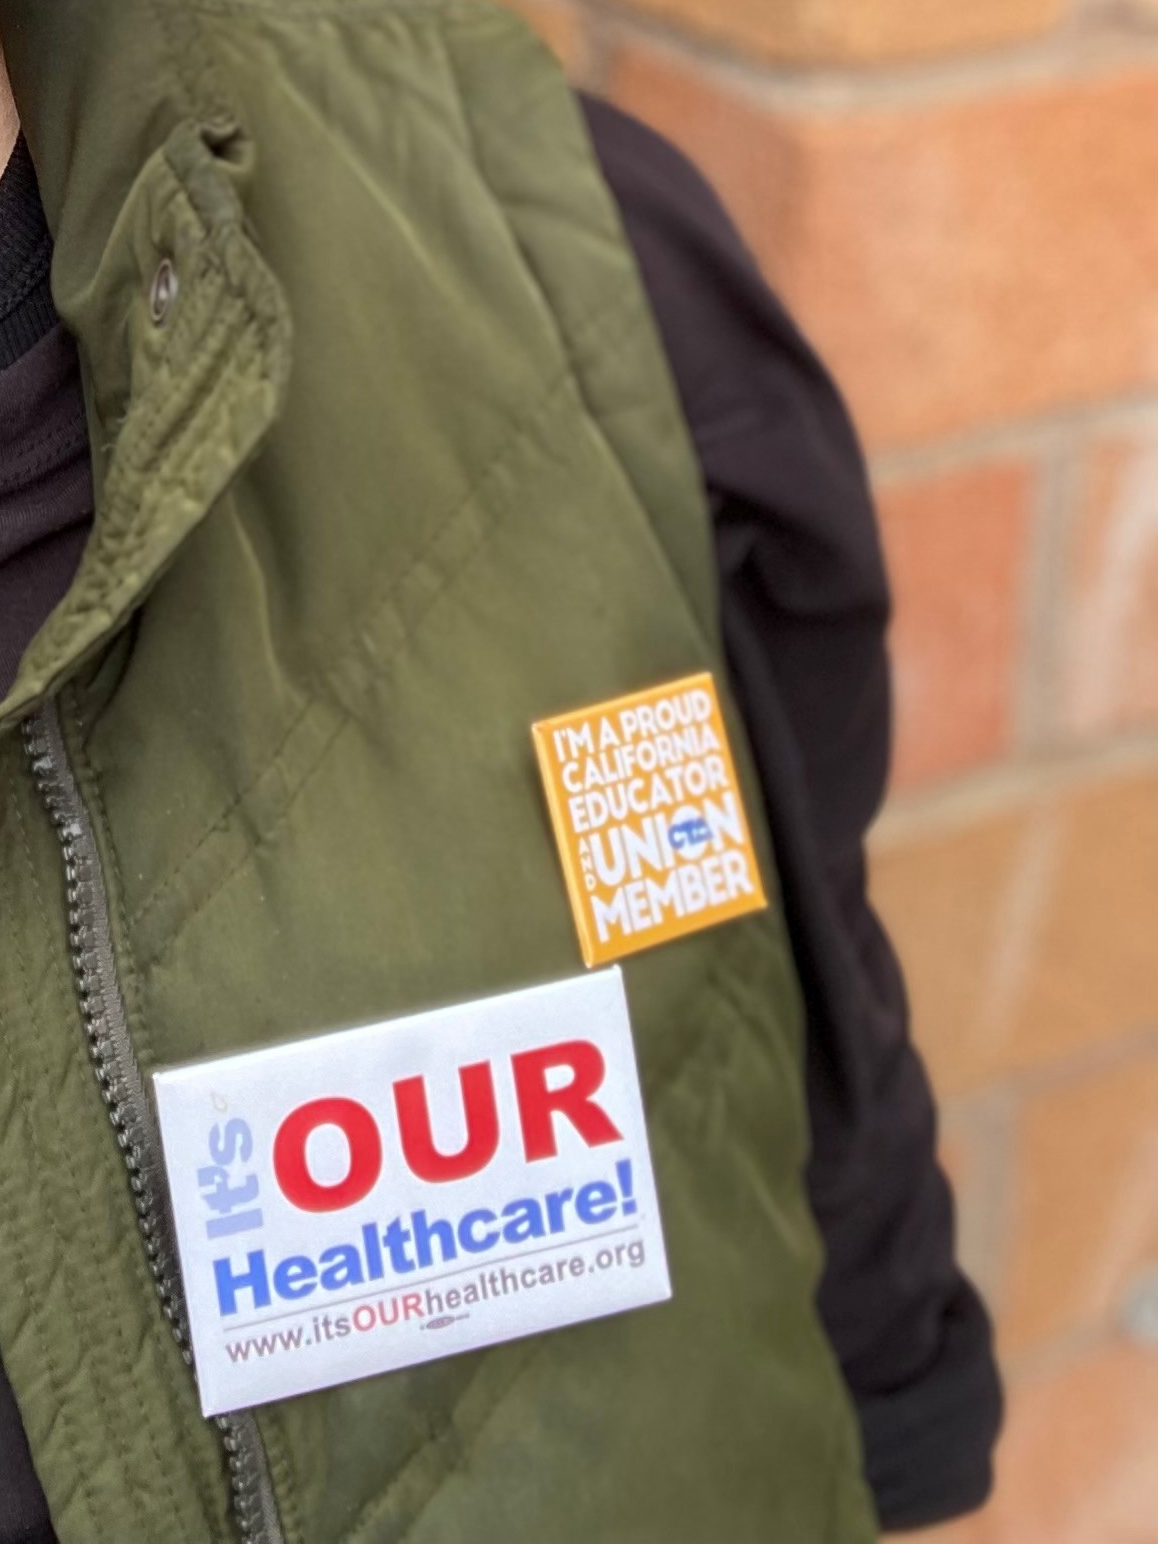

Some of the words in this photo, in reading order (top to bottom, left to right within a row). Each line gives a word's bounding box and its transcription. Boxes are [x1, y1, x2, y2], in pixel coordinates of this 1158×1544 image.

[562, 723, 720, 793] CALIFORNIA
[599, 717, 618, 749] A
[620, 690, 710, 741] PROUD
[568, 755, 728, 833] EDUCATOR
[589, 791, 746, 886] UNION
[591, 850, 755, 943] MEMBER
[272, 1039, 624, 1213] OUR
[197, 1118, 264, 1240] It's
[213, 1158, 638, 1317] Healthcare!
[225, 1238, 645, 1363] www.itsOURhealthcare.org
